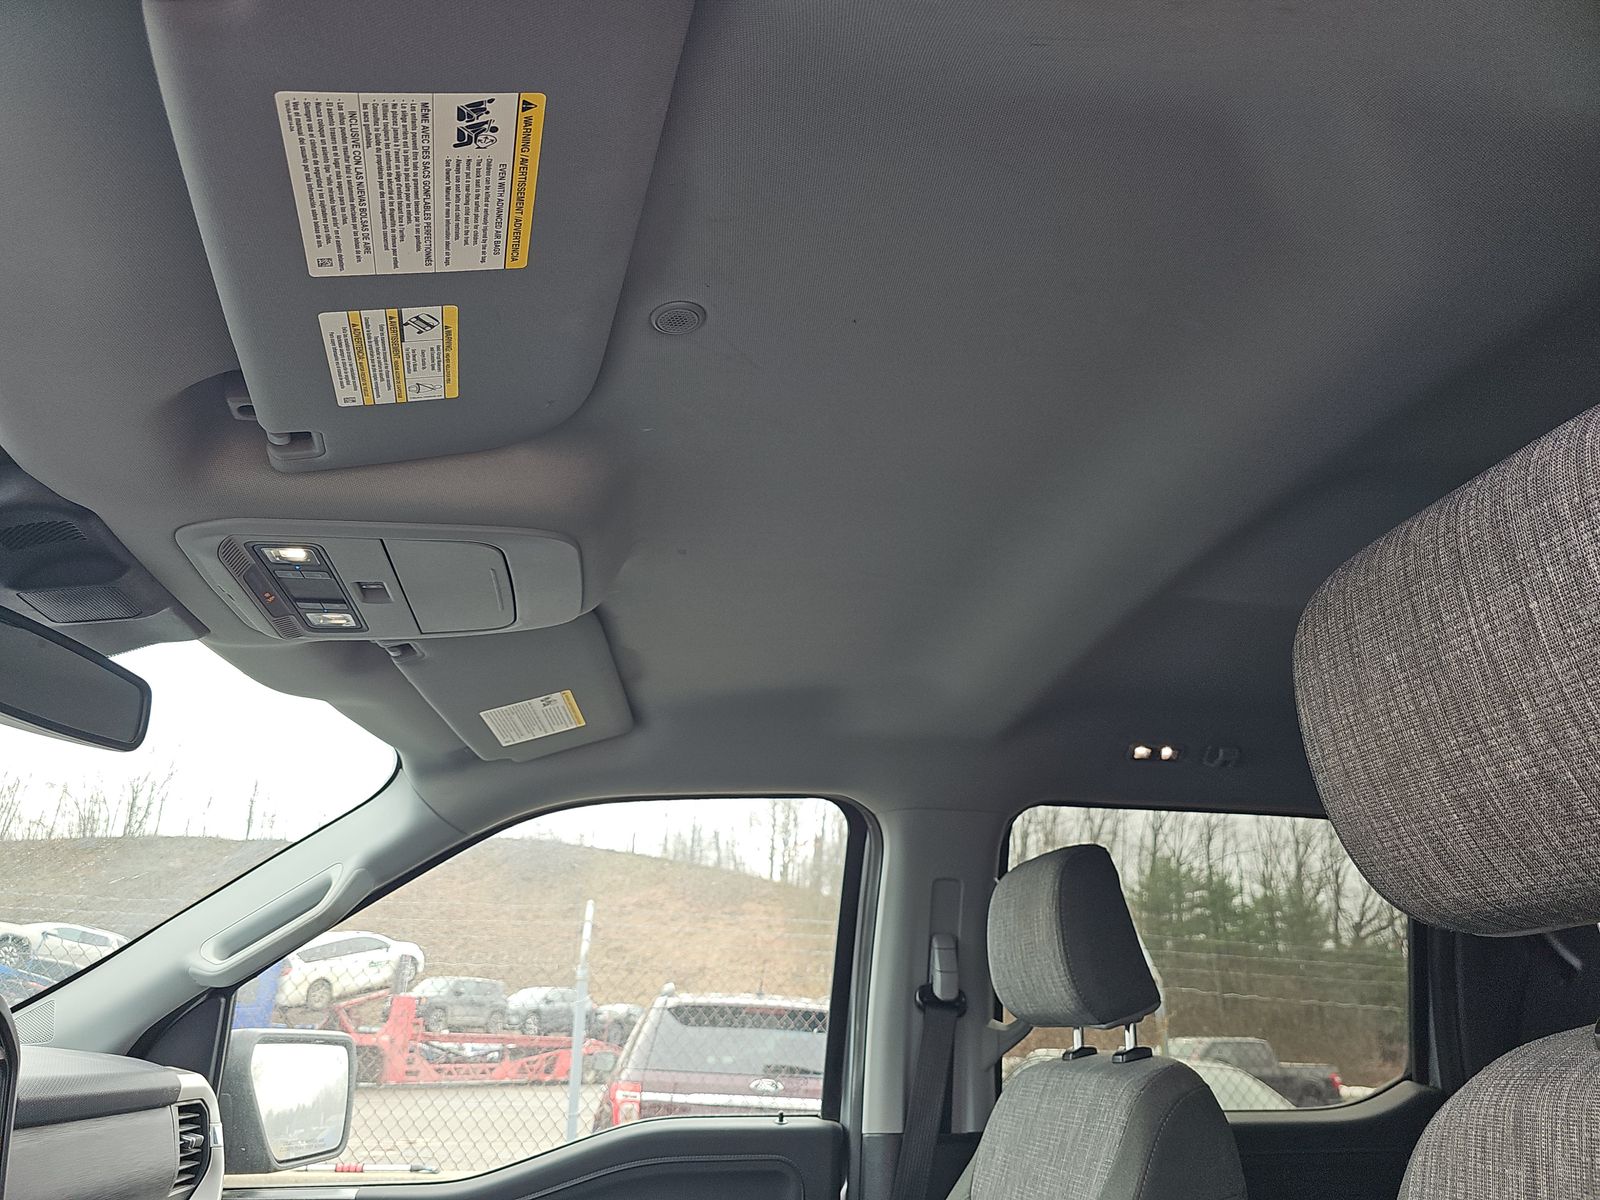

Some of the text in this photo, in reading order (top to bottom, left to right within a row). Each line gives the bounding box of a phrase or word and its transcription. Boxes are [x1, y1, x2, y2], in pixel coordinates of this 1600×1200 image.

[348, 111, 371, 255] INCLUSIVE CON LAS NUEVAS BOLSAS DE AIRE
[420, 102, 433, 266] MÊME AVEC DES SACS GONFLABLES PERFECTIONNÉS
[520, 116, 533, 153] WARNING
[493, 163, 507, 256] EVEN WITH ADVANCED AIR BAGS
